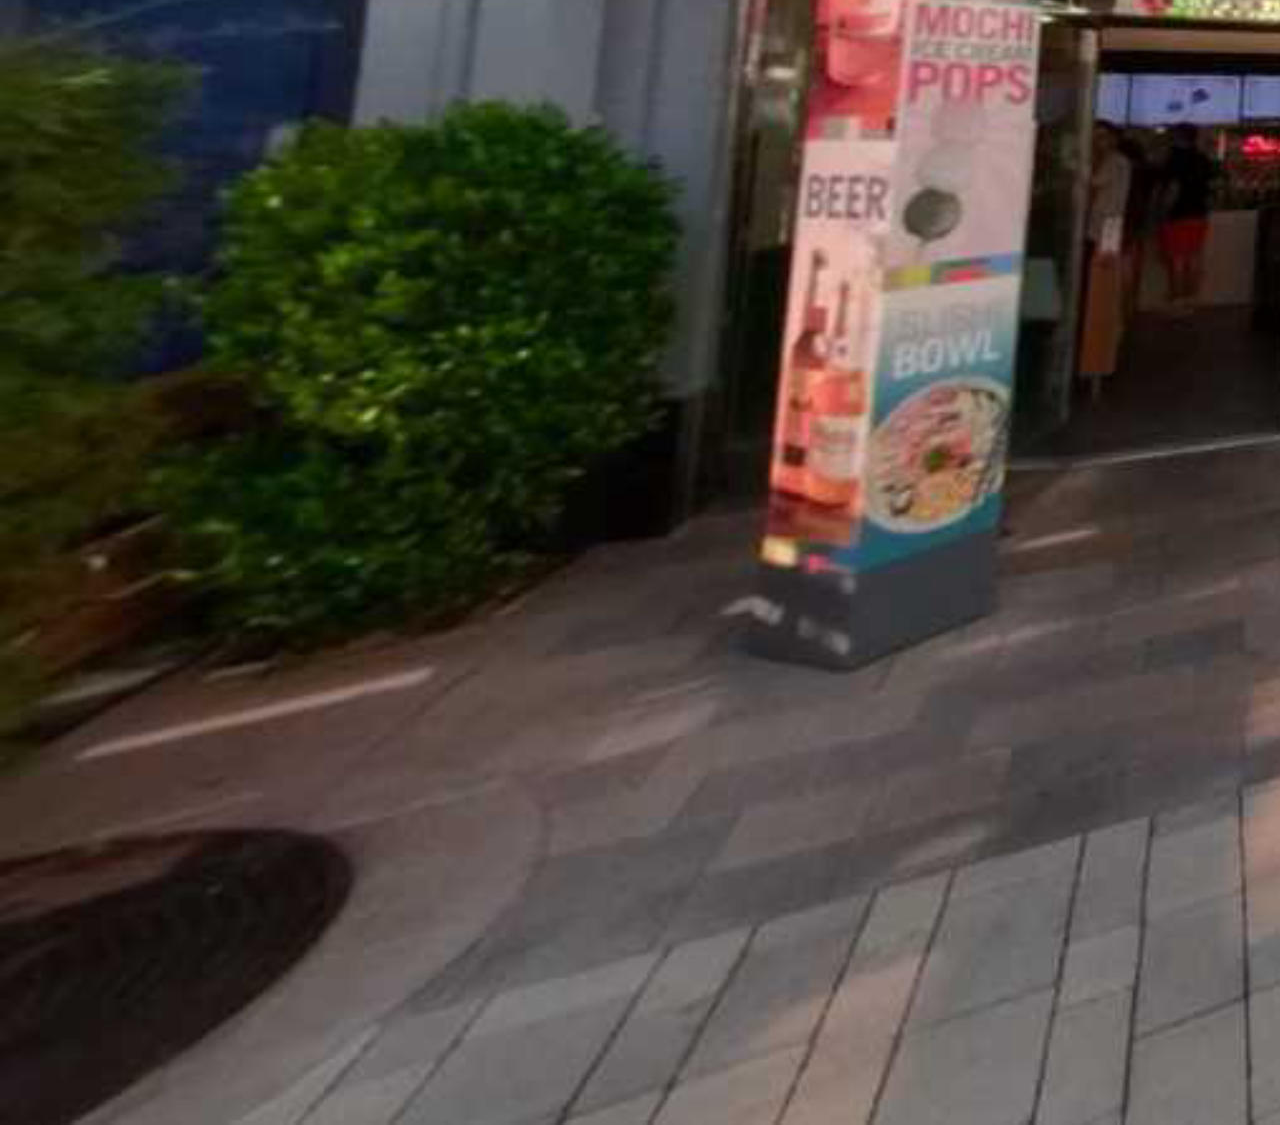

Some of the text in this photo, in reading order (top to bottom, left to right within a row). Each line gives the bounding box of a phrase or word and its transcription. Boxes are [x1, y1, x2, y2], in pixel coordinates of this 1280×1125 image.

[915, 4, 1034, 43] MOCHI
[907, 60, 1032, 106] POPS
[805, 175, 889, 221] BEER
[892, 331, 1002, 381] BOWL
